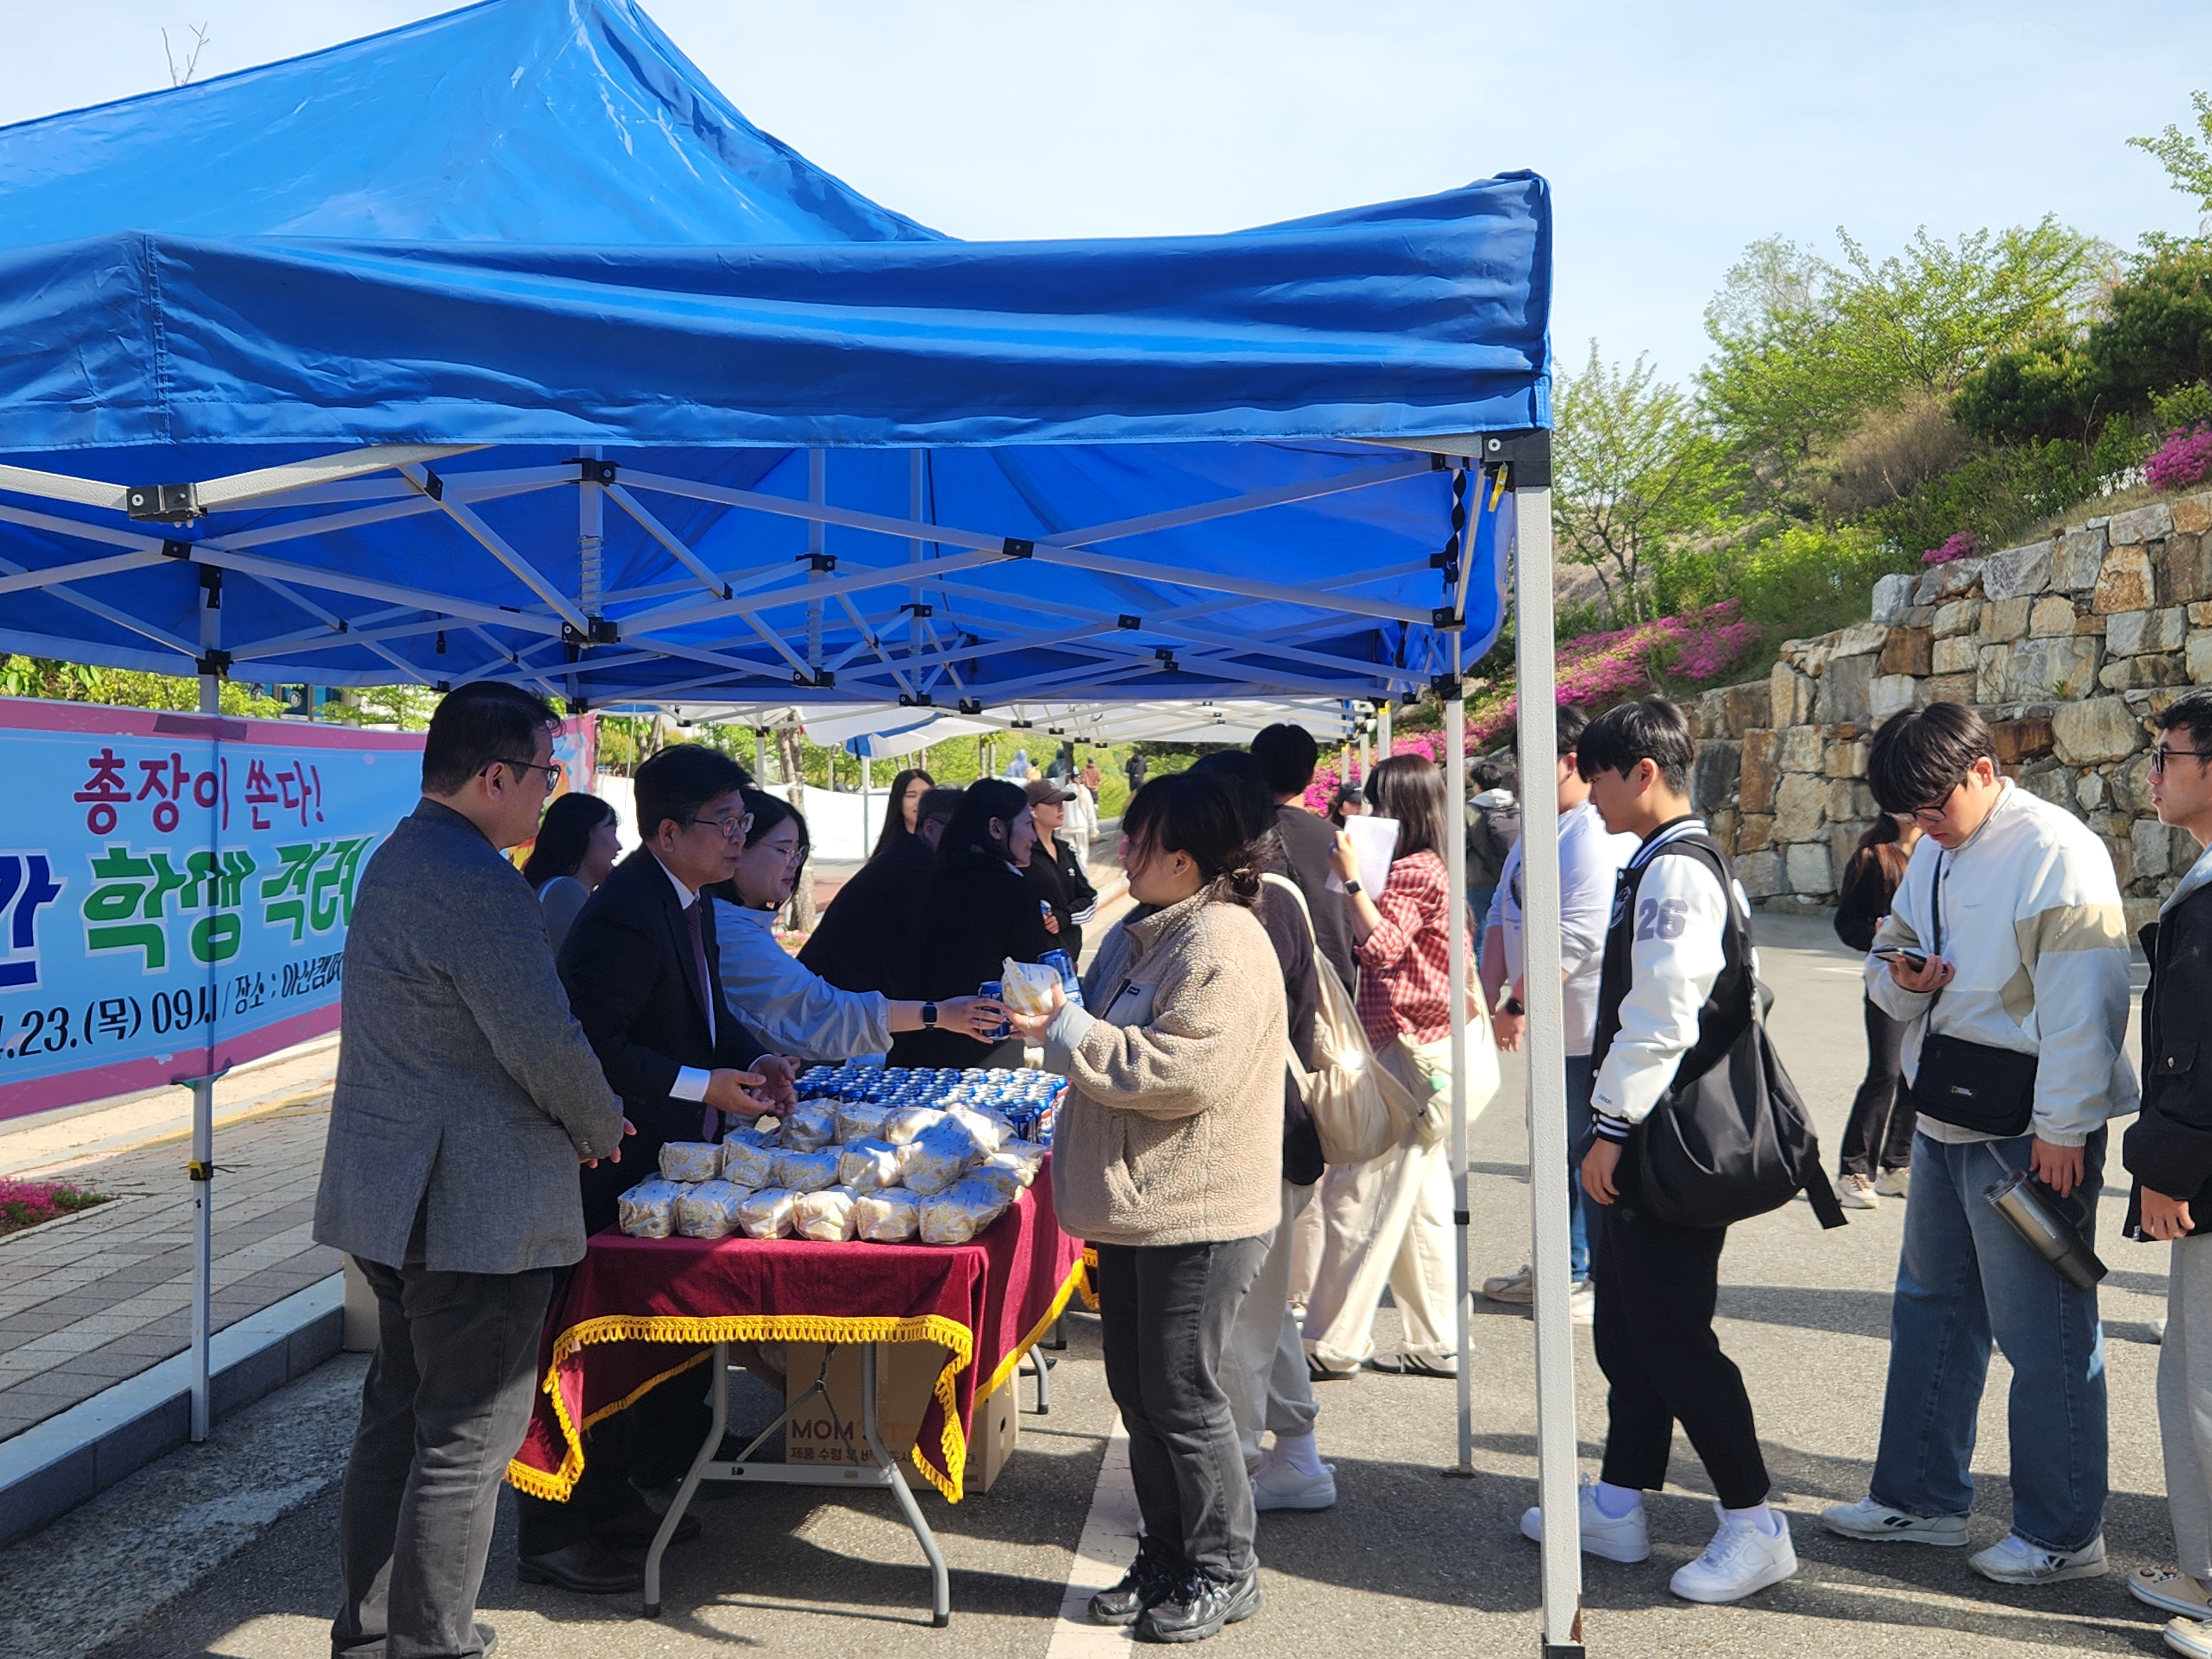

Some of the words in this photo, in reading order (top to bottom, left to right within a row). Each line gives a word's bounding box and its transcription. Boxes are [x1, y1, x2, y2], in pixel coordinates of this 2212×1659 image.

[73, 748, 229, 835] 총장이
[244, 758, 325, 830] 쏜다!
[82, 847, 257, 969] 학생
[261, 835, 374, 941] 격려
[1636, 897, 1688, 942] 26
[0, 995, 142, 1060] .23.(목)
[791, 1447, 815, 1460] 제품
[819, 1447, 843, 1460] 수령
